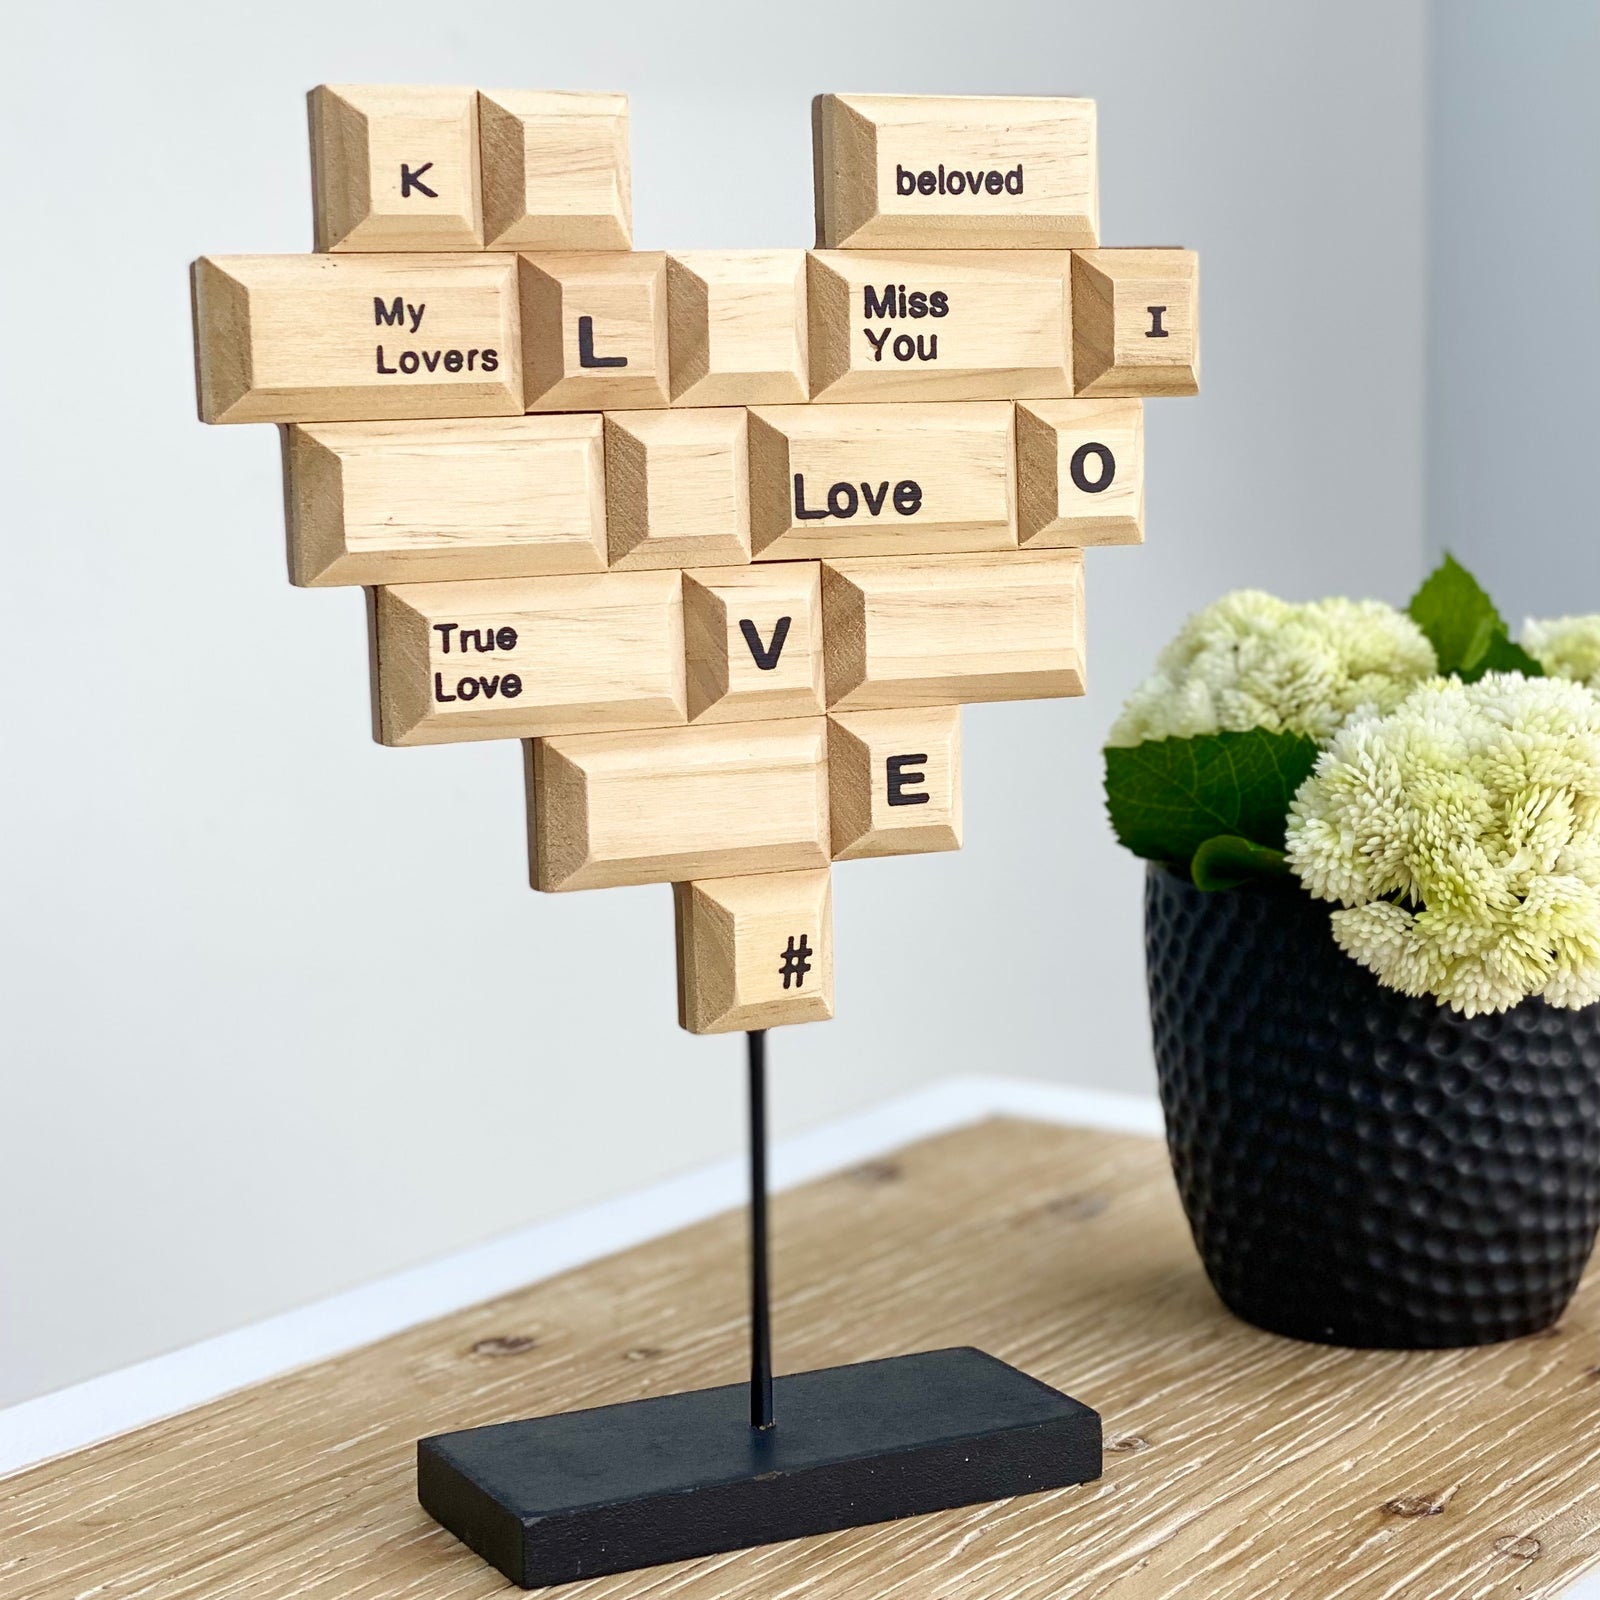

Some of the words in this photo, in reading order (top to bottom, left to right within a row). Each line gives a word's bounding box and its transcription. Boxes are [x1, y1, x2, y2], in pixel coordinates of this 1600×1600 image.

[401, 162, 439, 198] K
[896, 163, 1024, 196] beloved
[373, 296, 427, 333] My
[863, 284, 950, 320] Miss
[1144, 306, 1169, 338] I
[376, 345, 499, 375] Lovers
[578, 315, 628, 369] L
[863, 327, 938, 362] You
[1069, 442, 1116, 494] O
[793, 473, 923, 520] Love
[432, 623, 518, 654] True
[738, 616, 792, 671] V
[434, 672, 523, 703] Love
[886, 753, 930, 807] E
[778, 934, 813, 990] #
